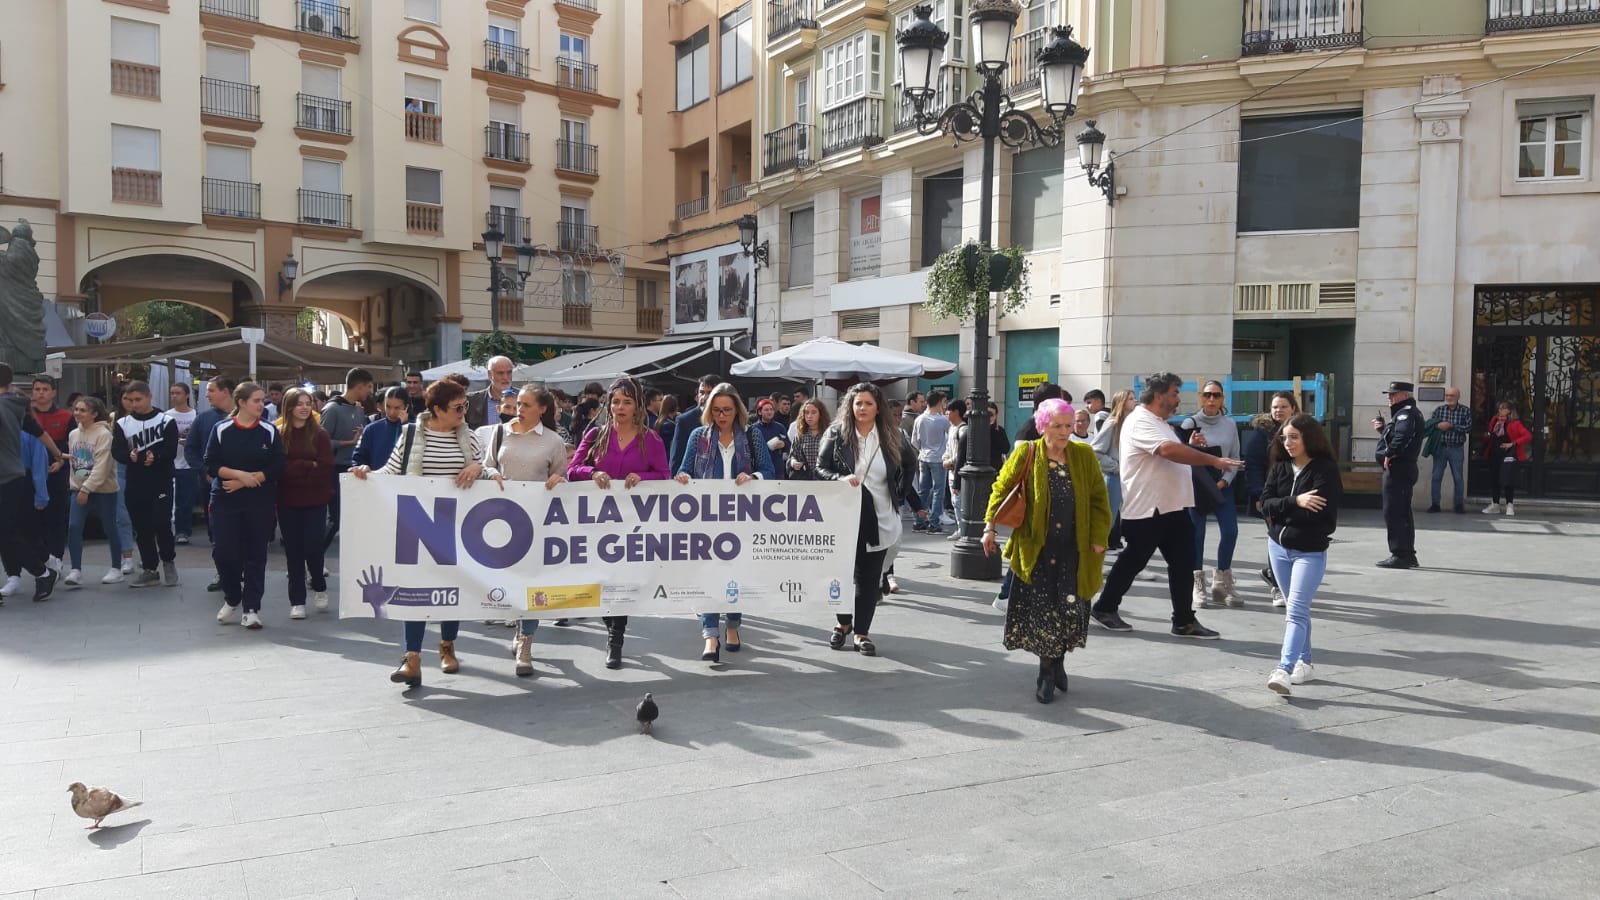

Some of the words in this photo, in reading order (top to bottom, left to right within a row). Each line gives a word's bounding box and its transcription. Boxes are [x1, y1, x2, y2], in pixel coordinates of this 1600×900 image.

[543, 497, 569, 525] A
[578, 495, 623, 524] LA
[631, 494, 824, 523] VIOLENCIA
[395, 494, 534, 569] NO
[543, 535, 588, 565] DE
[597, 526, 741, 563] GÉNERO
[752, 533, 767, 545] 25
[770, 534, 836, 546] NOVIEMBRE
[431, 590, 457, 605] 016
